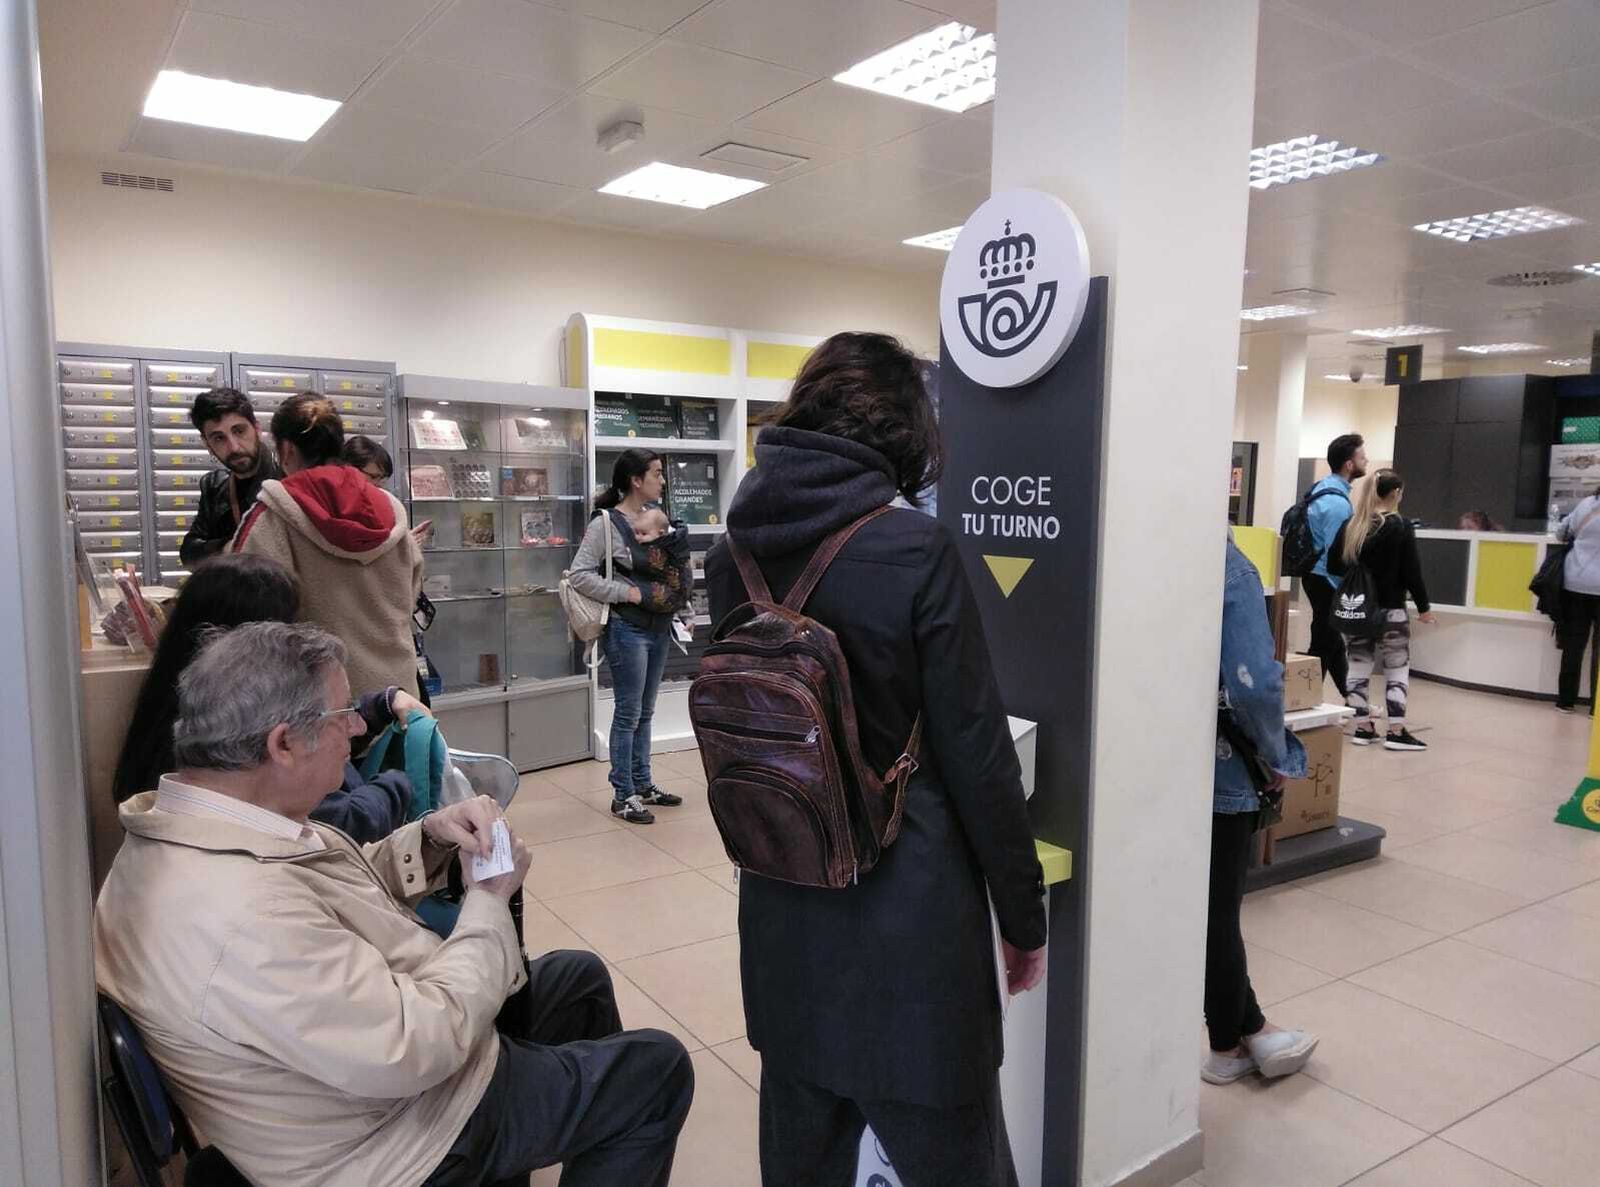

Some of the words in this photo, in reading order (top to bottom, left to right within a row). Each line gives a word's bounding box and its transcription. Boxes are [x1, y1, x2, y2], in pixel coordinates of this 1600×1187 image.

[1398, 354, 1409, 377] 1
[971, 475, 1052, 506] COGE
[961, 512, 985, 536] TU
[990, 514, 1061, 540] TURNO
[1335, 609, 1366, 620] adidas
